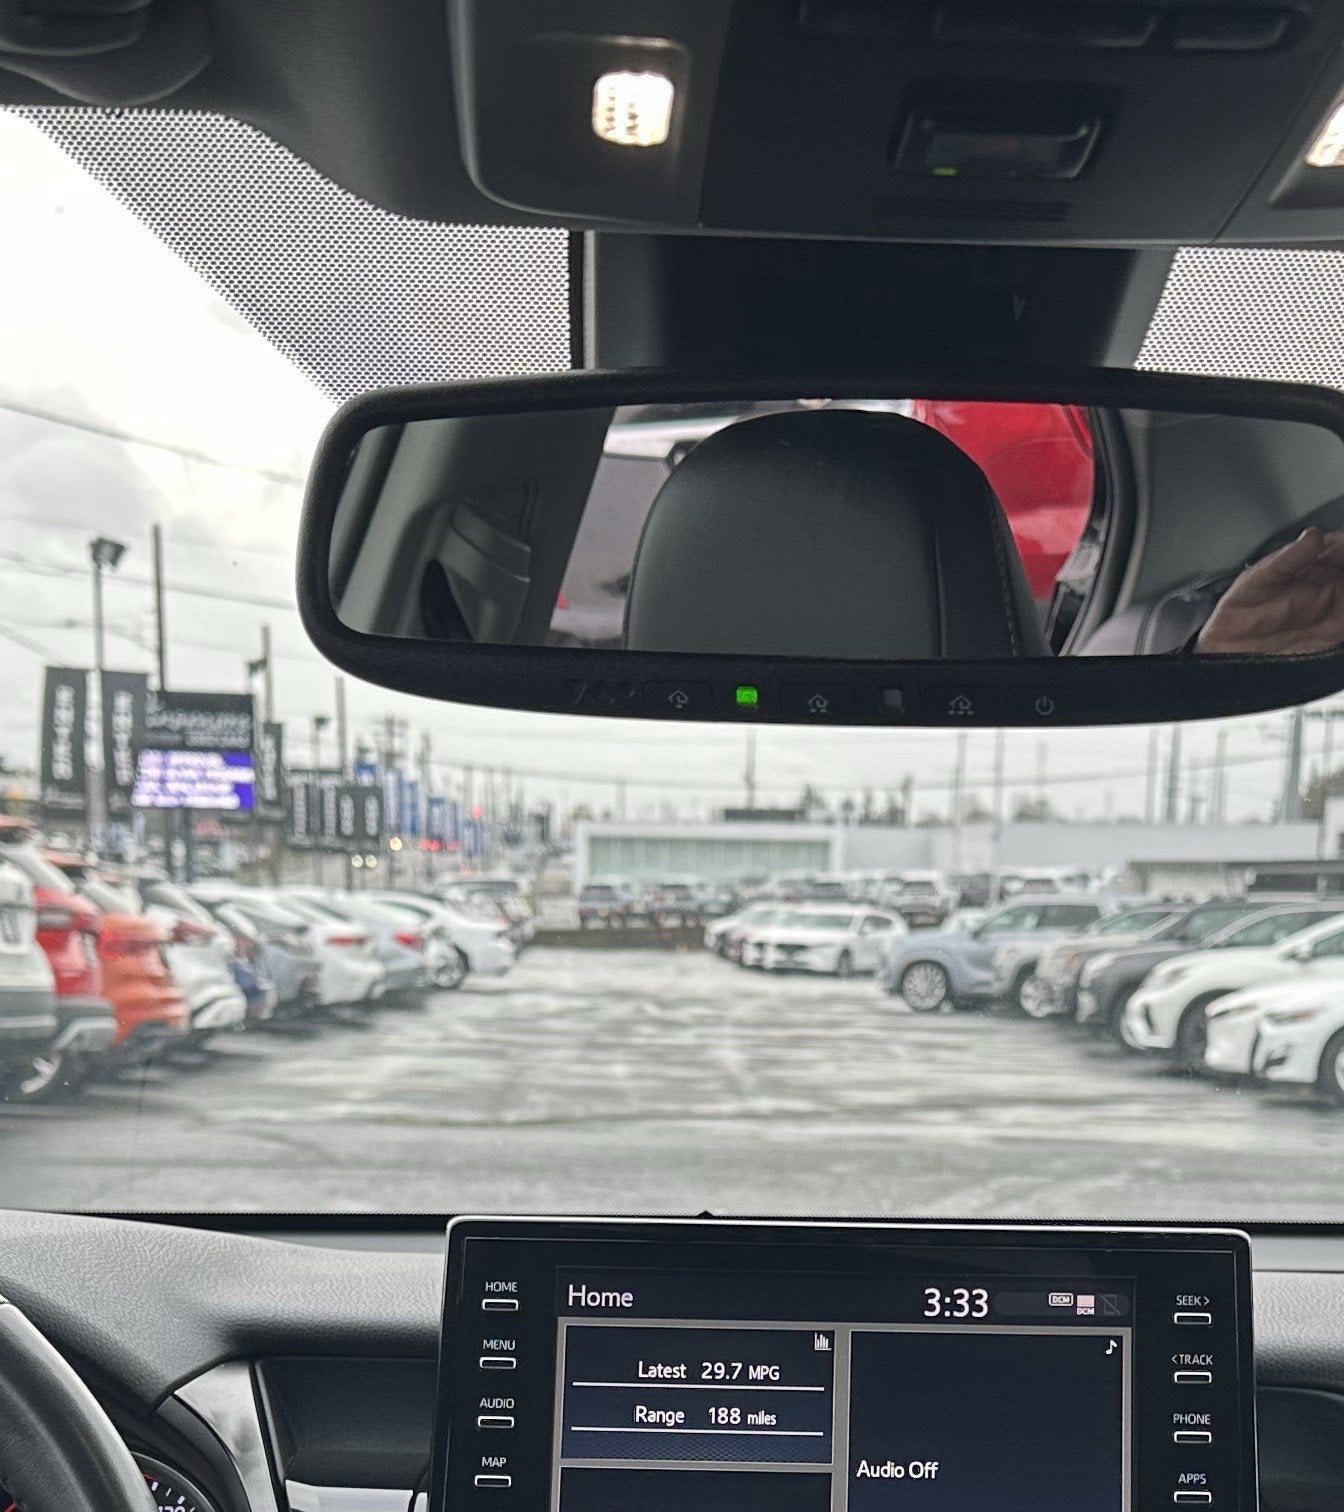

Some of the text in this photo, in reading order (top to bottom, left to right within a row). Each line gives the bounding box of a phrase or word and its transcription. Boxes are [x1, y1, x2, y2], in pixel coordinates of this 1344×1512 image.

[484, 1281, 518, 1293] HOME
[567, 1283, 634, 1307] Home
[923, 1287, 989, 1318] 3:33
[482, 1339, 516, 1351] MENU
[637, 1360, 780, 1381] Latest 29.7 MPG
[479, 1398, 515, 1409] AUDIO
[635, 1405, 777, 1425] Range 188 miles
[1173, 1413, 1211, 1425] PHONE
[481, 1456, 507, 1468] MAP
[856, 1460, 939, 1479] Audio Off
[1178, 1473, 1207, 1484] APPS
